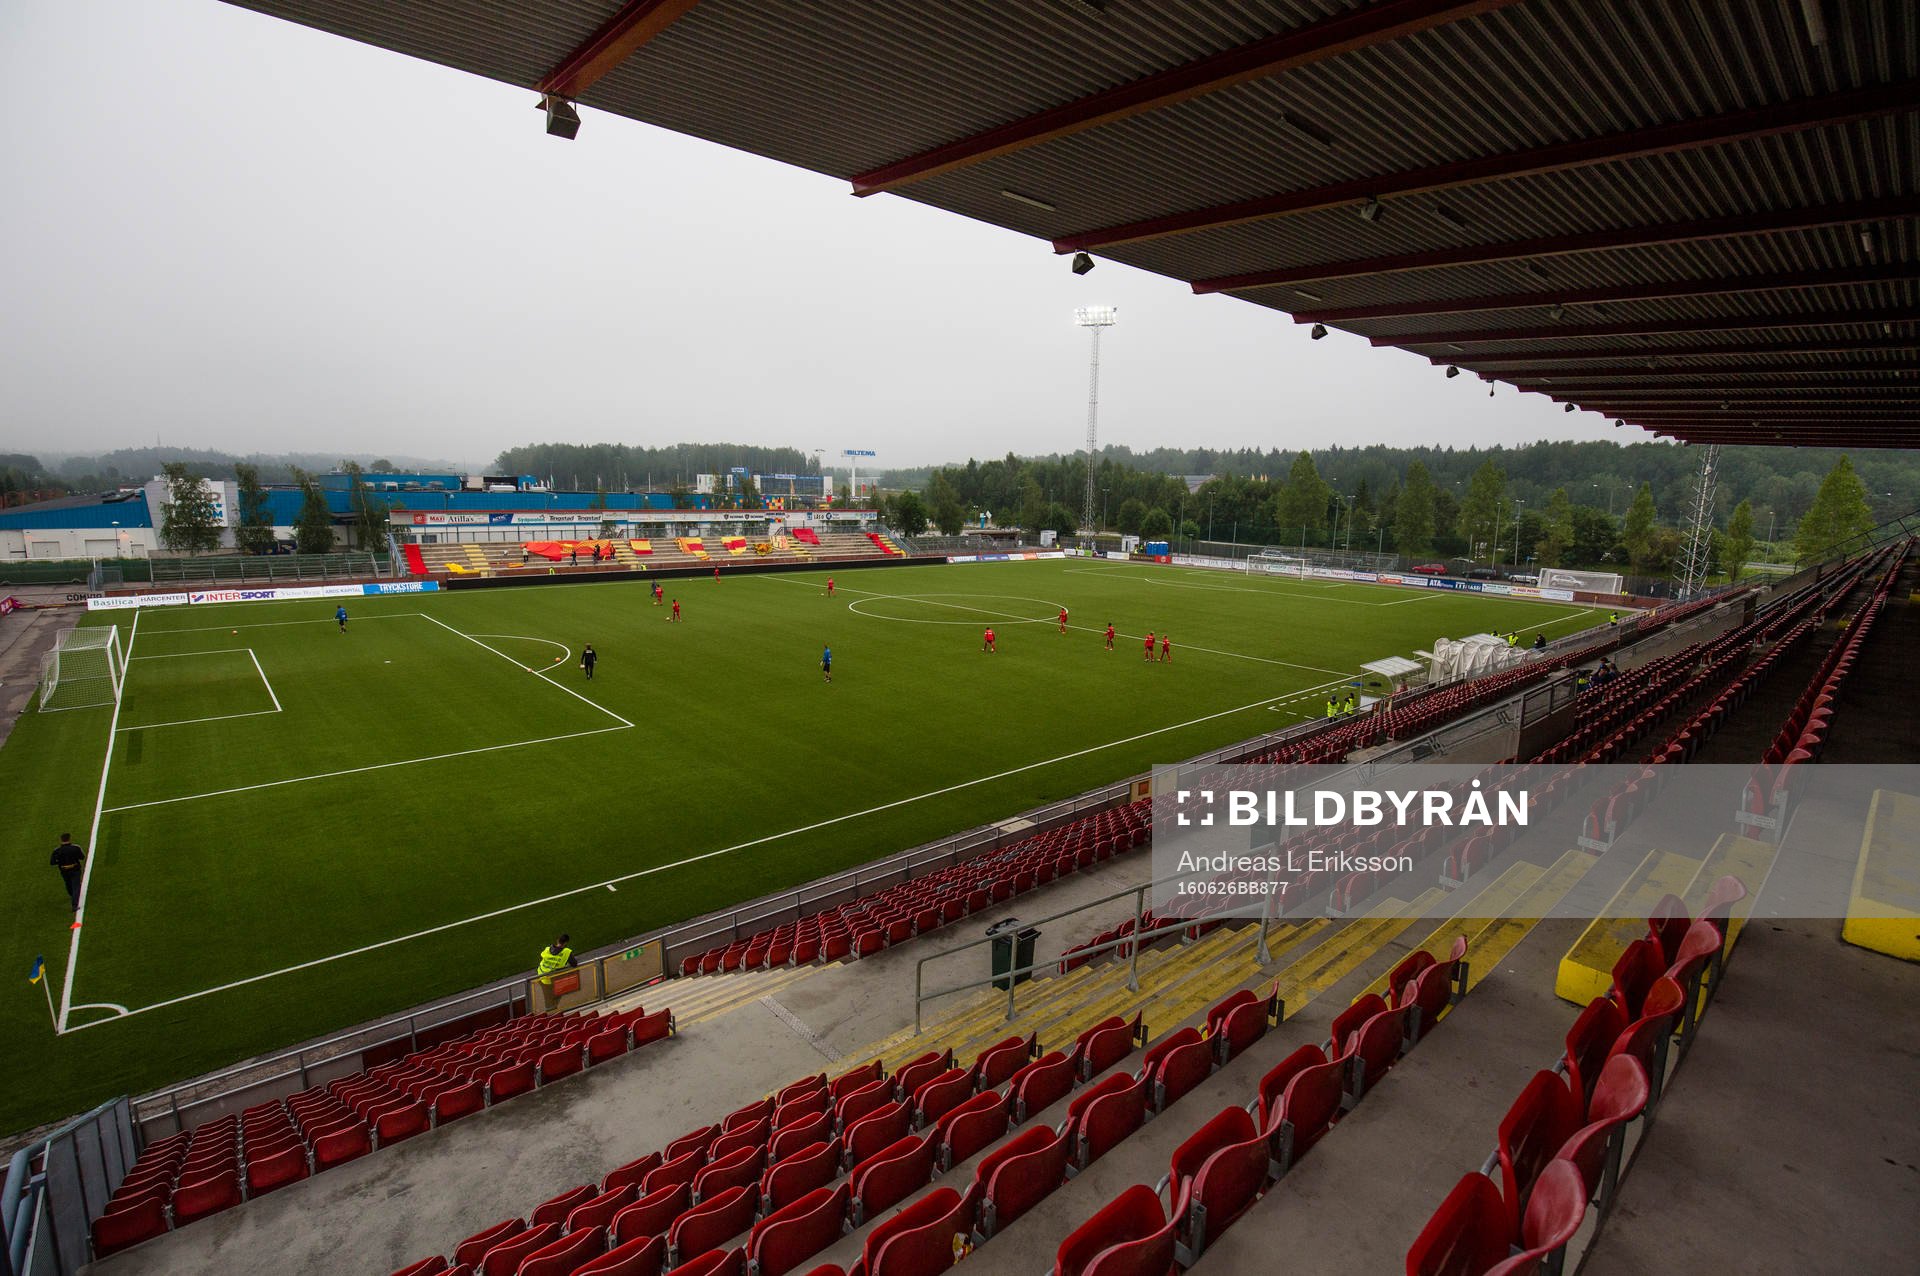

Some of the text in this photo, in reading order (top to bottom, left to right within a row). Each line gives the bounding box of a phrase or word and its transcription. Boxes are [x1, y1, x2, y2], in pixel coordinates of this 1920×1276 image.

[379, 582, 423, 591] TRYCKSTORE
[206, 590, 277, 601] INTERSPORT
[93, 599, 133, 607] Basilica
